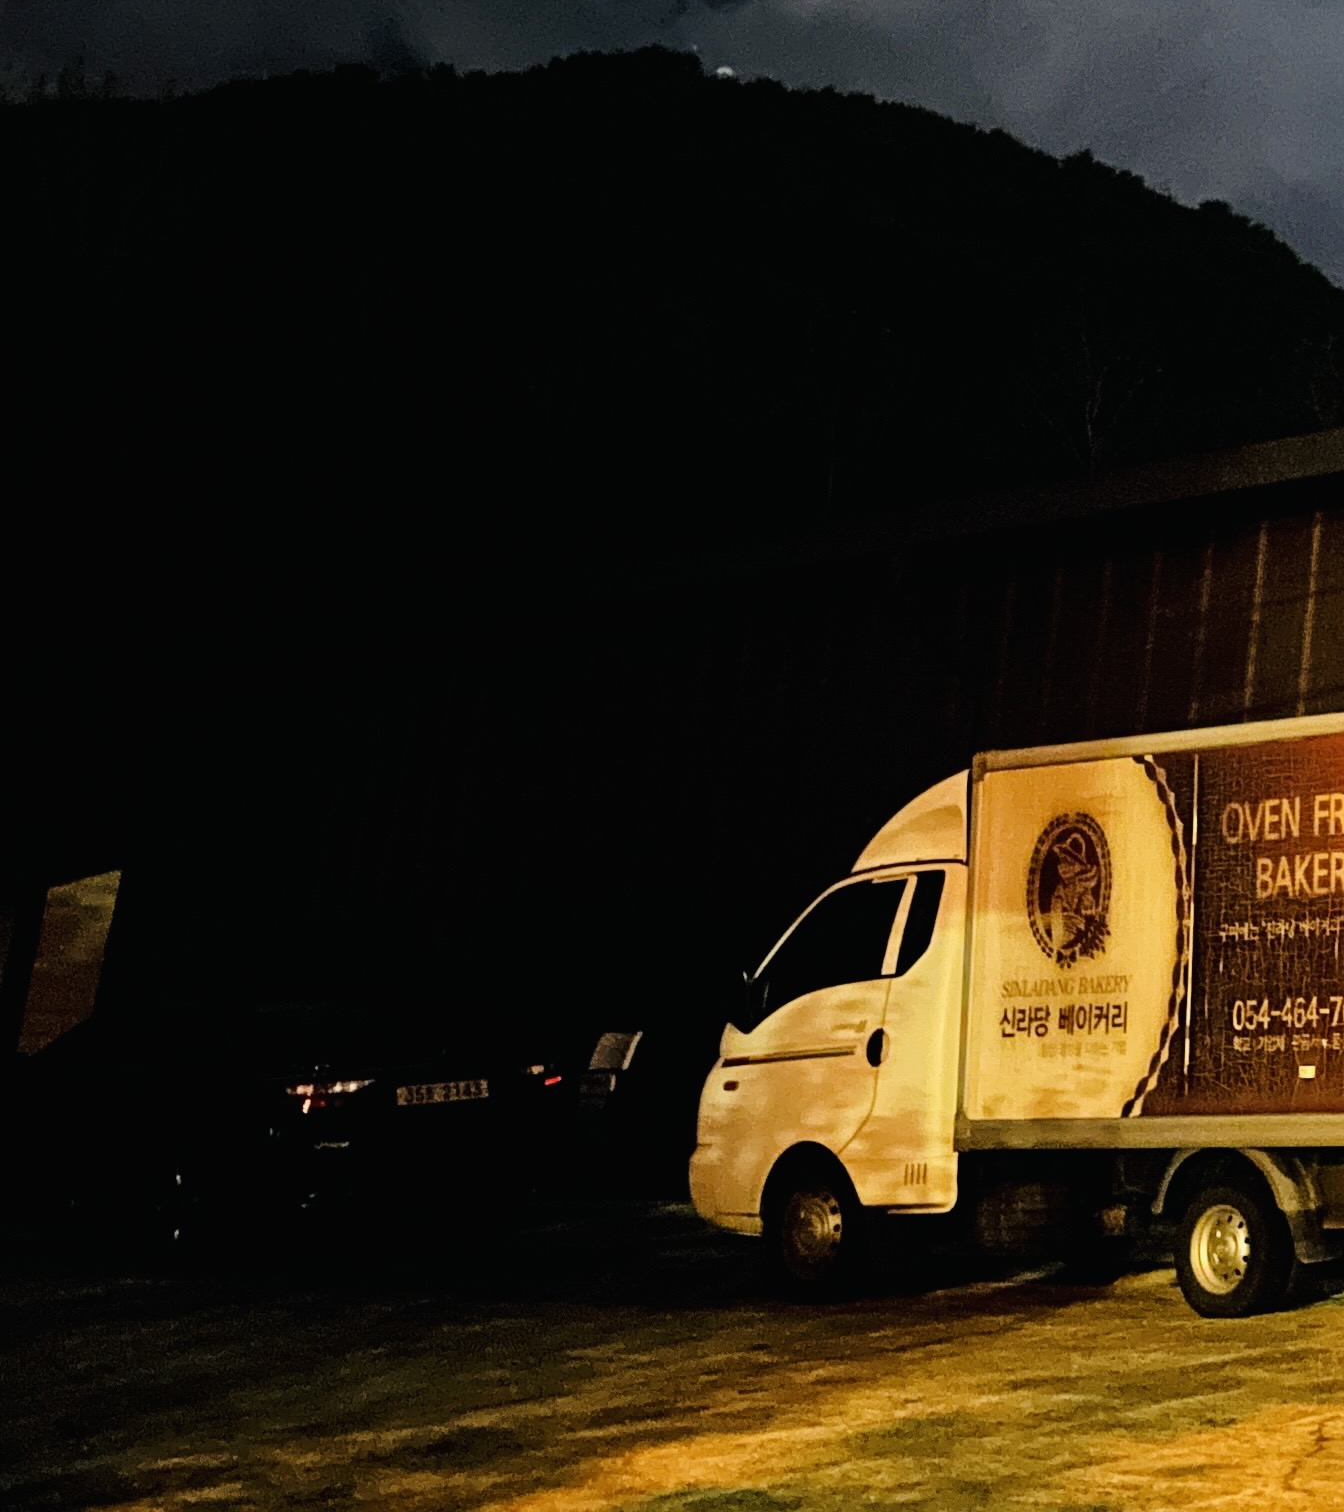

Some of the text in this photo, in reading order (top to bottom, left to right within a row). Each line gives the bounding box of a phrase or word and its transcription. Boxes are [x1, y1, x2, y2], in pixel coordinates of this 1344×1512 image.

[1222, 797, 1299, 844] OVEN
[1000, 1001, 1128, 1038] 신라당 베이커리
